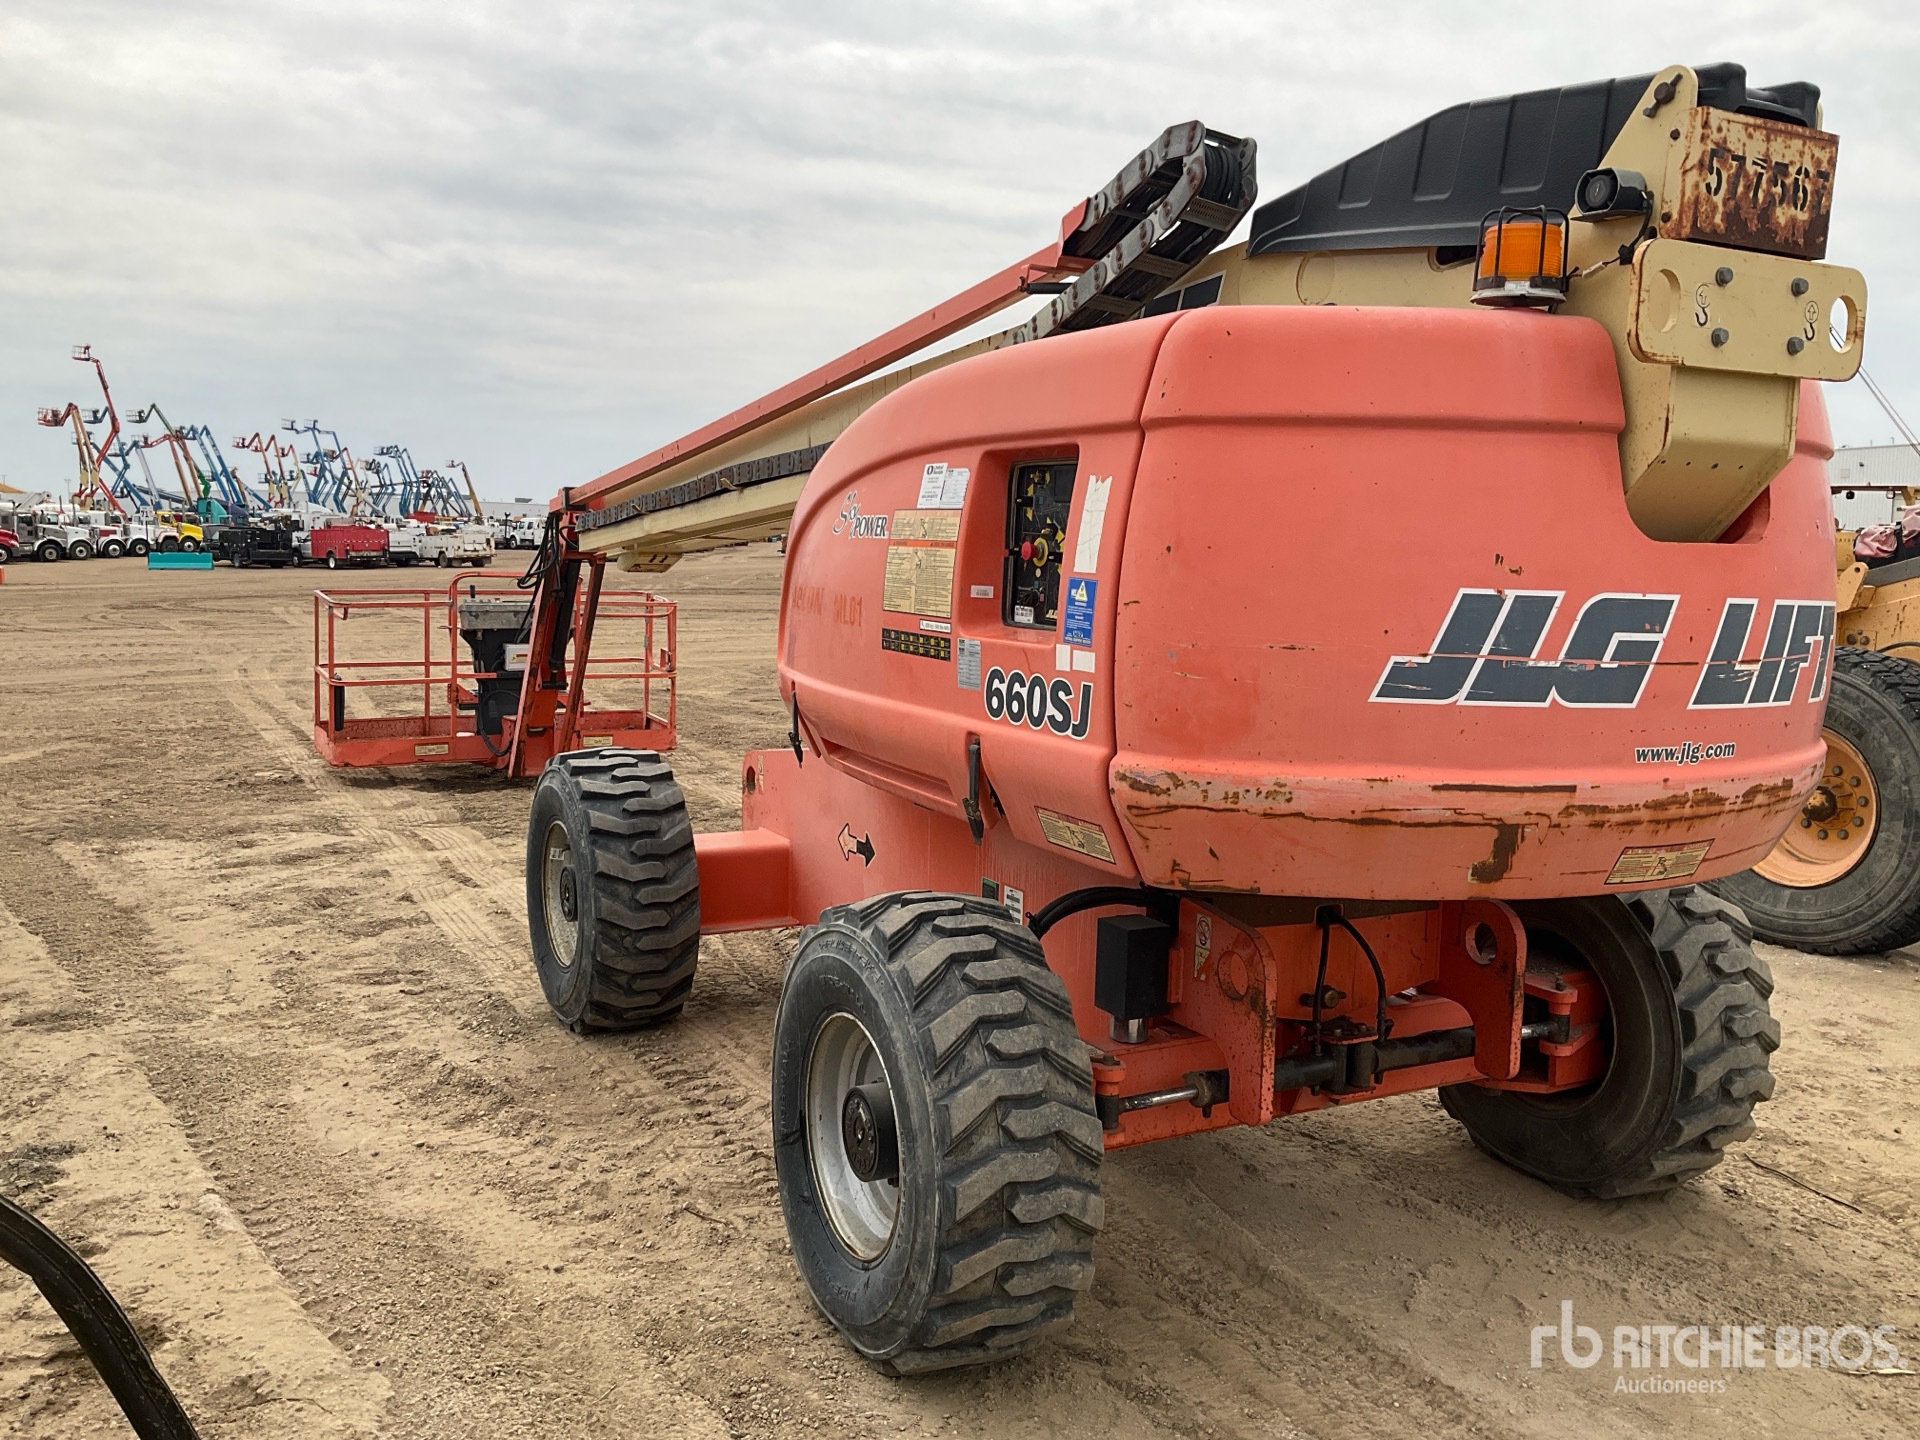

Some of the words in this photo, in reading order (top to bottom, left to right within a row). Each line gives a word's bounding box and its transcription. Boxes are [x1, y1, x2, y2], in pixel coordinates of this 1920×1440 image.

[852, 515, 886, 538] POWER
[1368, 588, 1681, 708] JLG
[984, 666, 1093, 739] 660SJ
[1635, 741, 1736, 765] www.jlg.com
